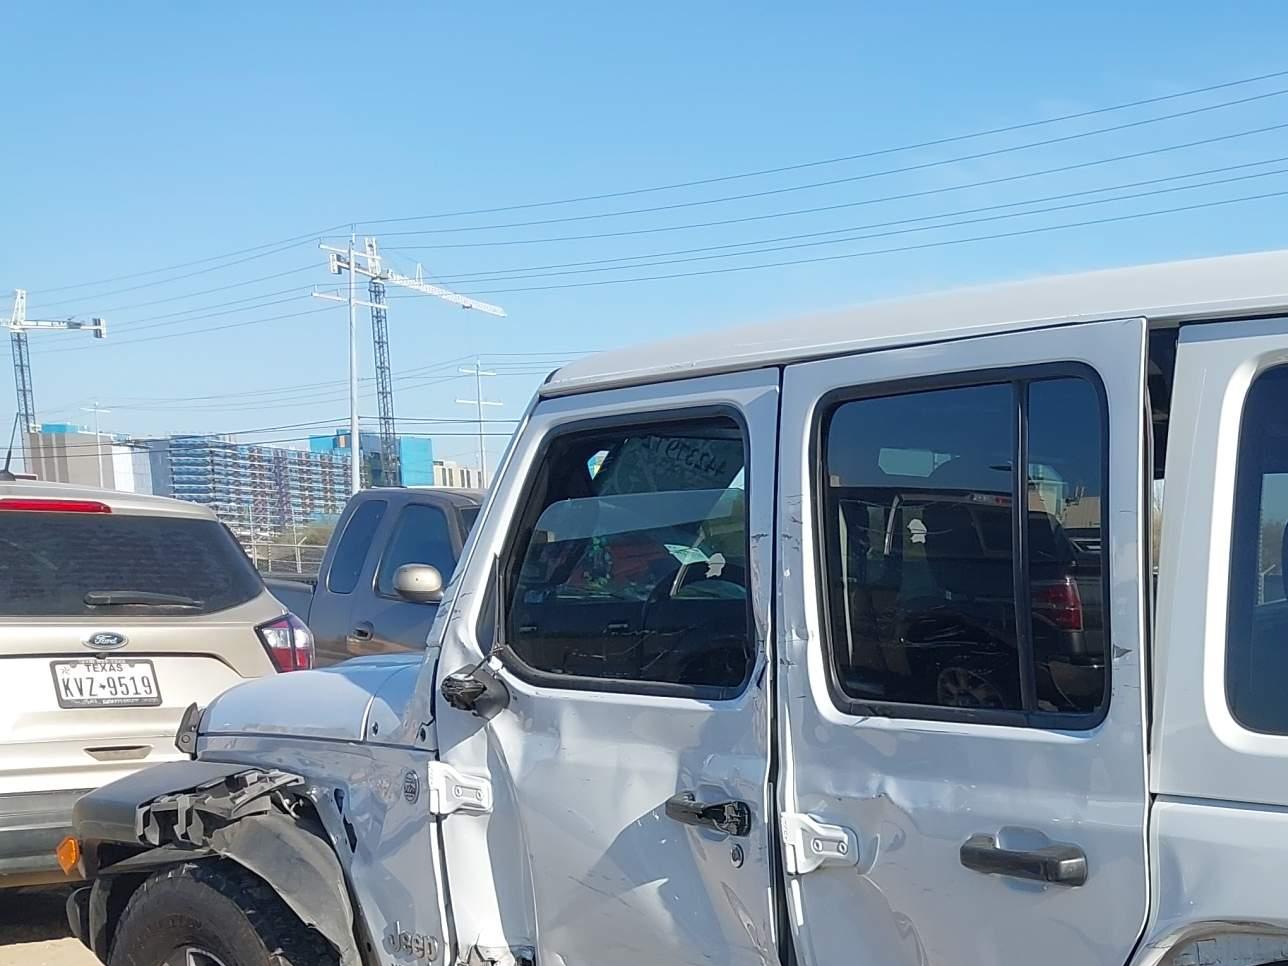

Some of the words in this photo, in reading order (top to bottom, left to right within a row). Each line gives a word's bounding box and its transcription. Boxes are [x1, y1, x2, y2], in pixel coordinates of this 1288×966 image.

[94, 634, 118, 645] Ford
[84, 662, 124, 673] TEXAS
[387, 920, 439, 966] Jeep
